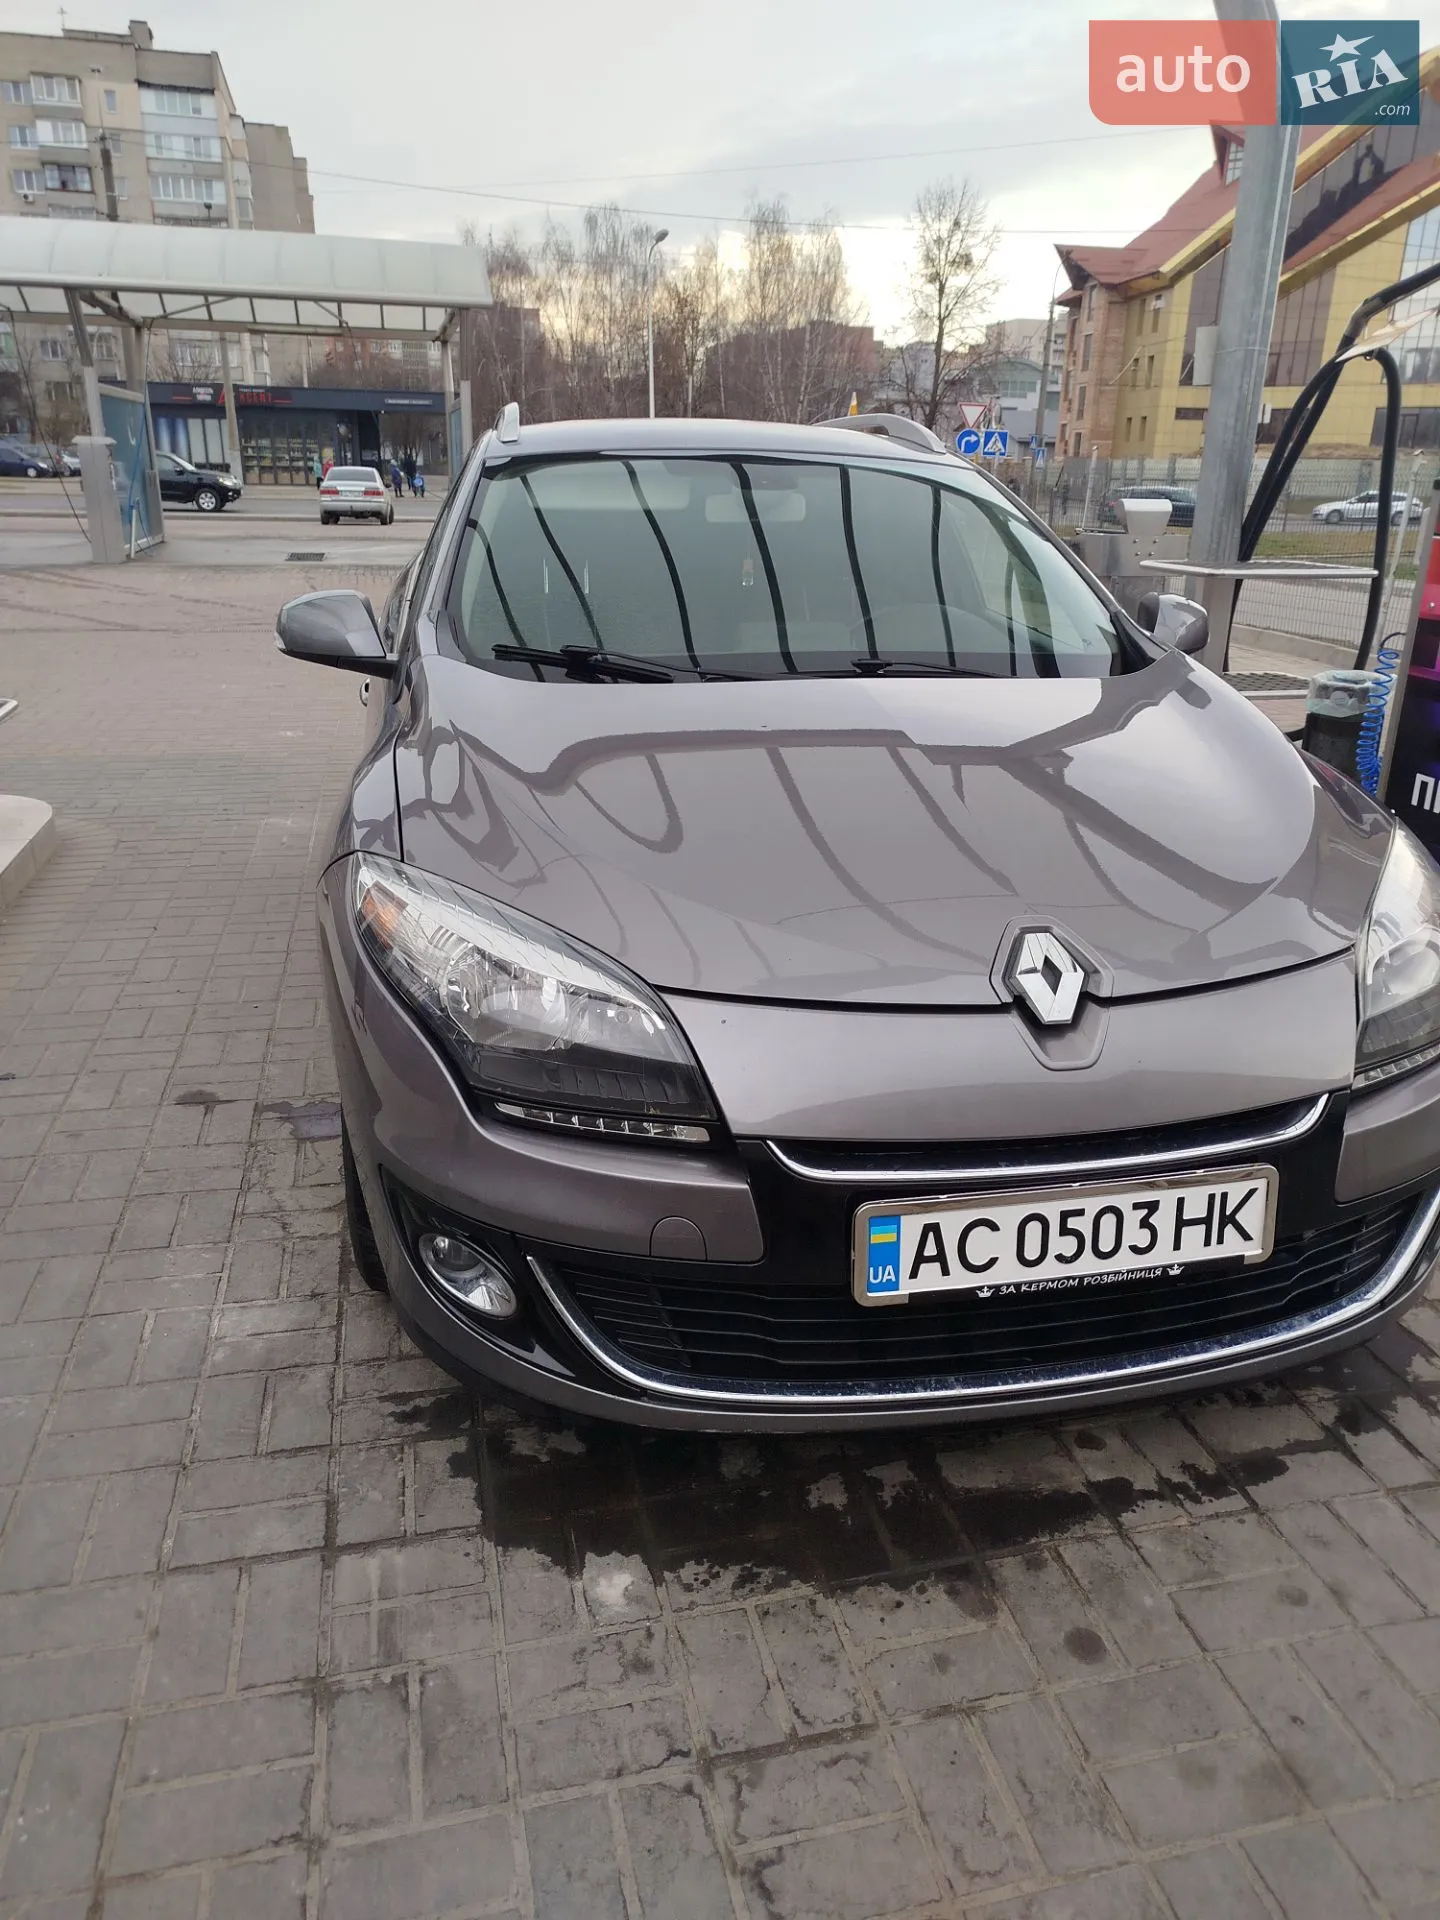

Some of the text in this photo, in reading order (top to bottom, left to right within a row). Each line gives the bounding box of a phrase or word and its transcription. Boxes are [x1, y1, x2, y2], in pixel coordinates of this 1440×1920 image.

[908, 1187, 1259, 1280] AC 0503 HK
[869, 1264, 897, 1284] UA
[999, 1267, 1163, 1295] ЗА КЕРМОМ РОЗБІЙНИЦЯ
